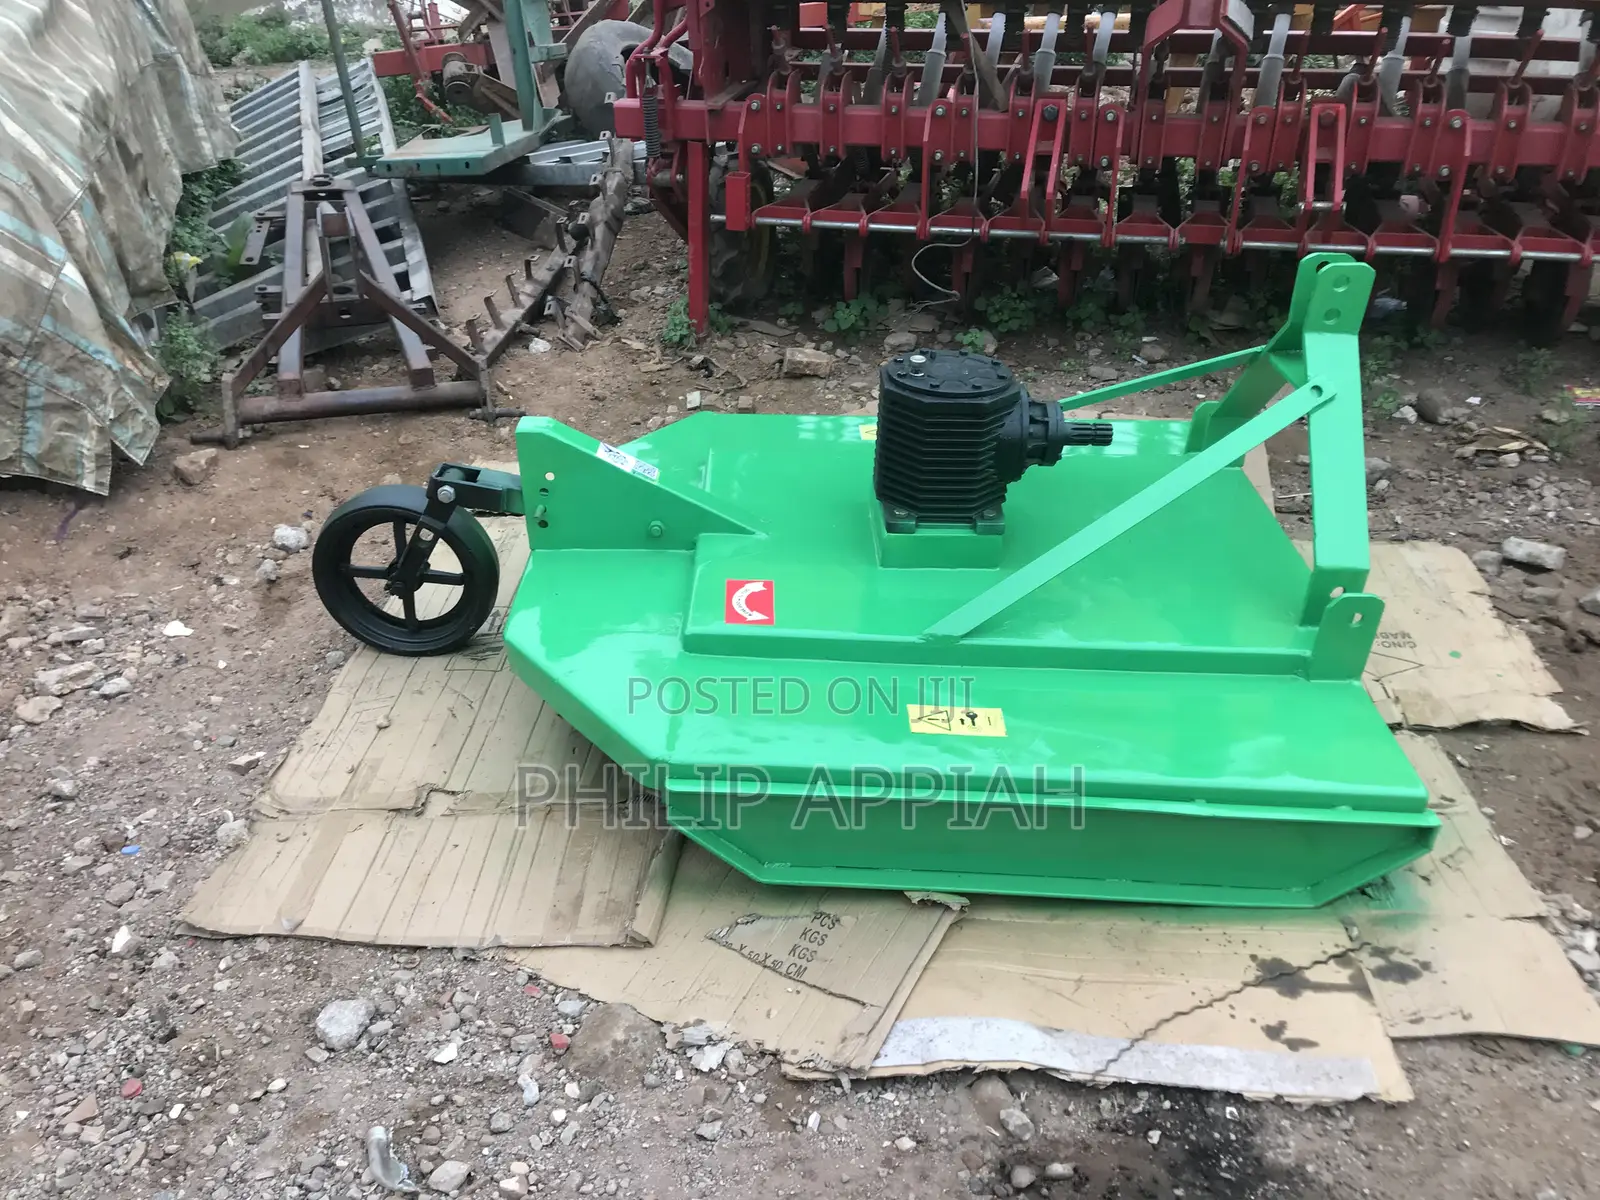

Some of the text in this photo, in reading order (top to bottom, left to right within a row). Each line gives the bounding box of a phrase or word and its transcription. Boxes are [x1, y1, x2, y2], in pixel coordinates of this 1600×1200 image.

[811, 911, 837, 930] PCS
[799, 927, 828, 946] KGS
[788, 943, 817, 962] KGS
[771, 959, 783, 969] 50
[785, 963, 808, 978] CM
